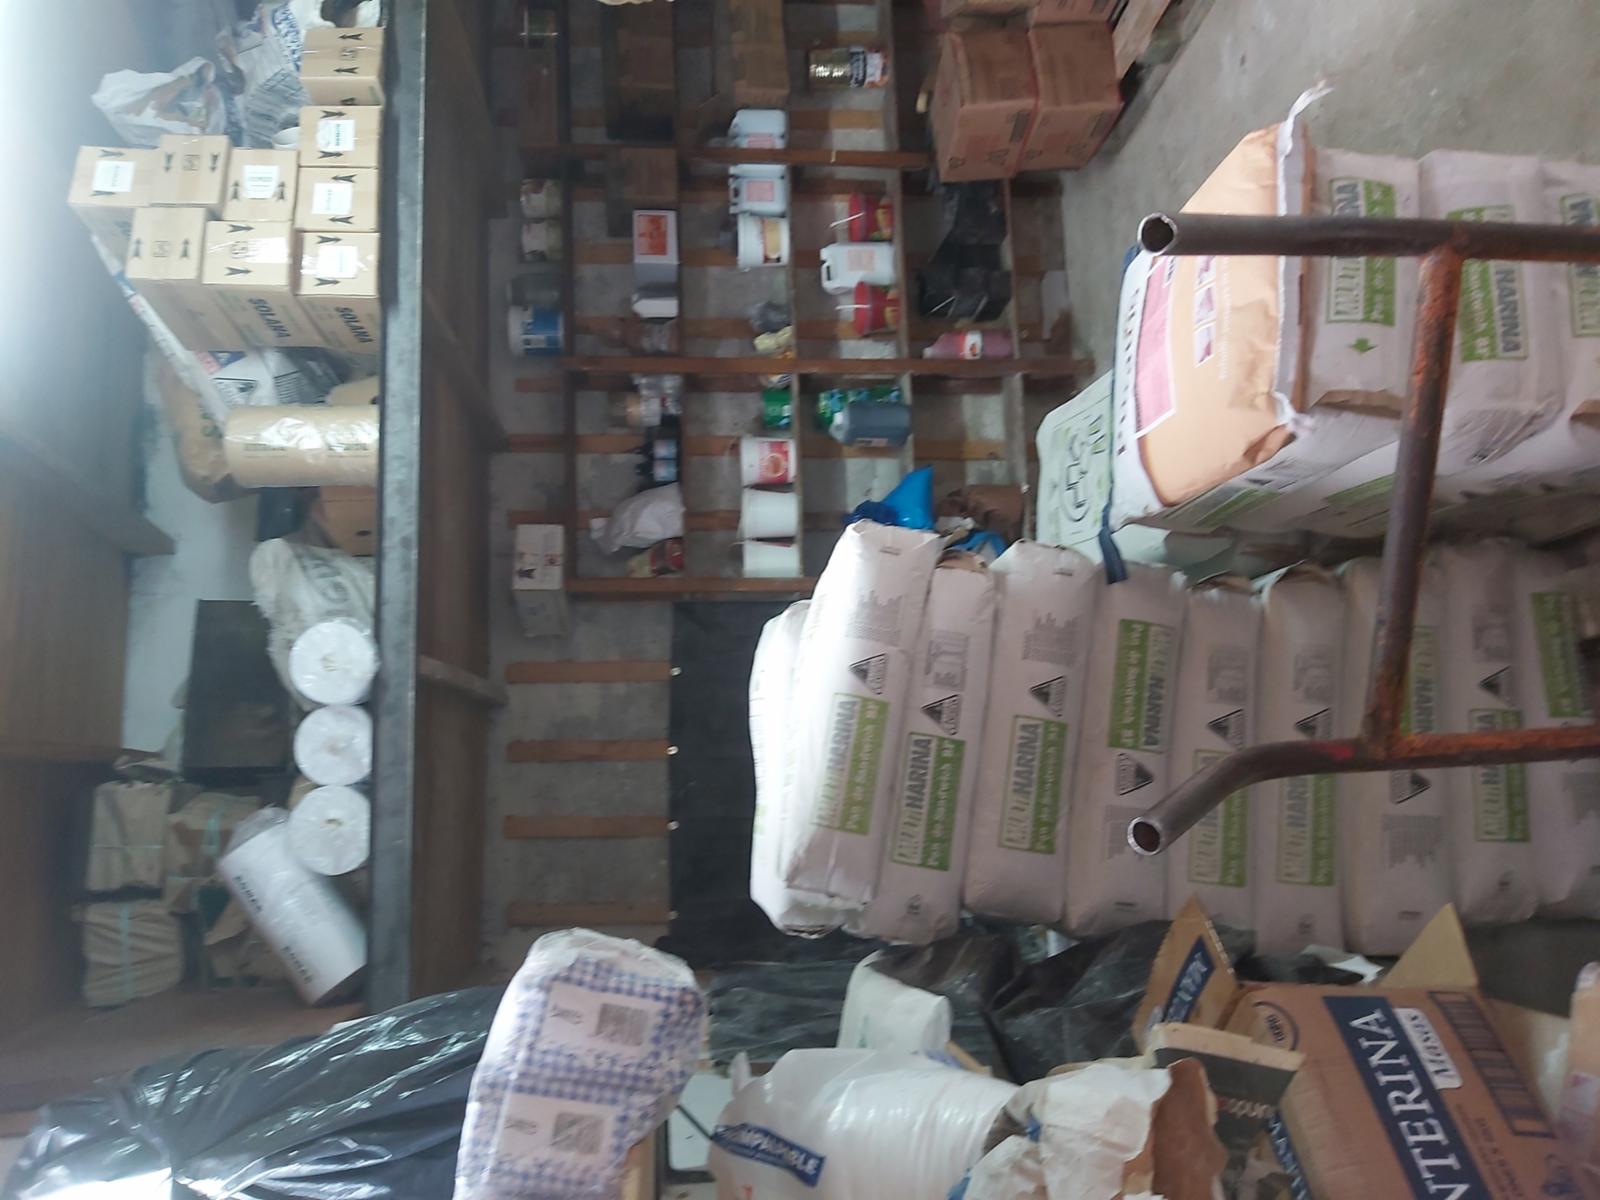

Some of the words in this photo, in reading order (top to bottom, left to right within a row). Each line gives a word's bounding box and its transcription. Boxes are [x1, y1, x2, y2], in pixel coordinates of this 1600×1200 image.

[850, 786, 864, 800] de
[934, 763, 952, 821] Sandwich
[846, 806, 862, 830] Pan
[931, 822, 944, 837] de
[927, 843, 942, 866] Pan
[1408, 1013, 1455, 1077] Masas
